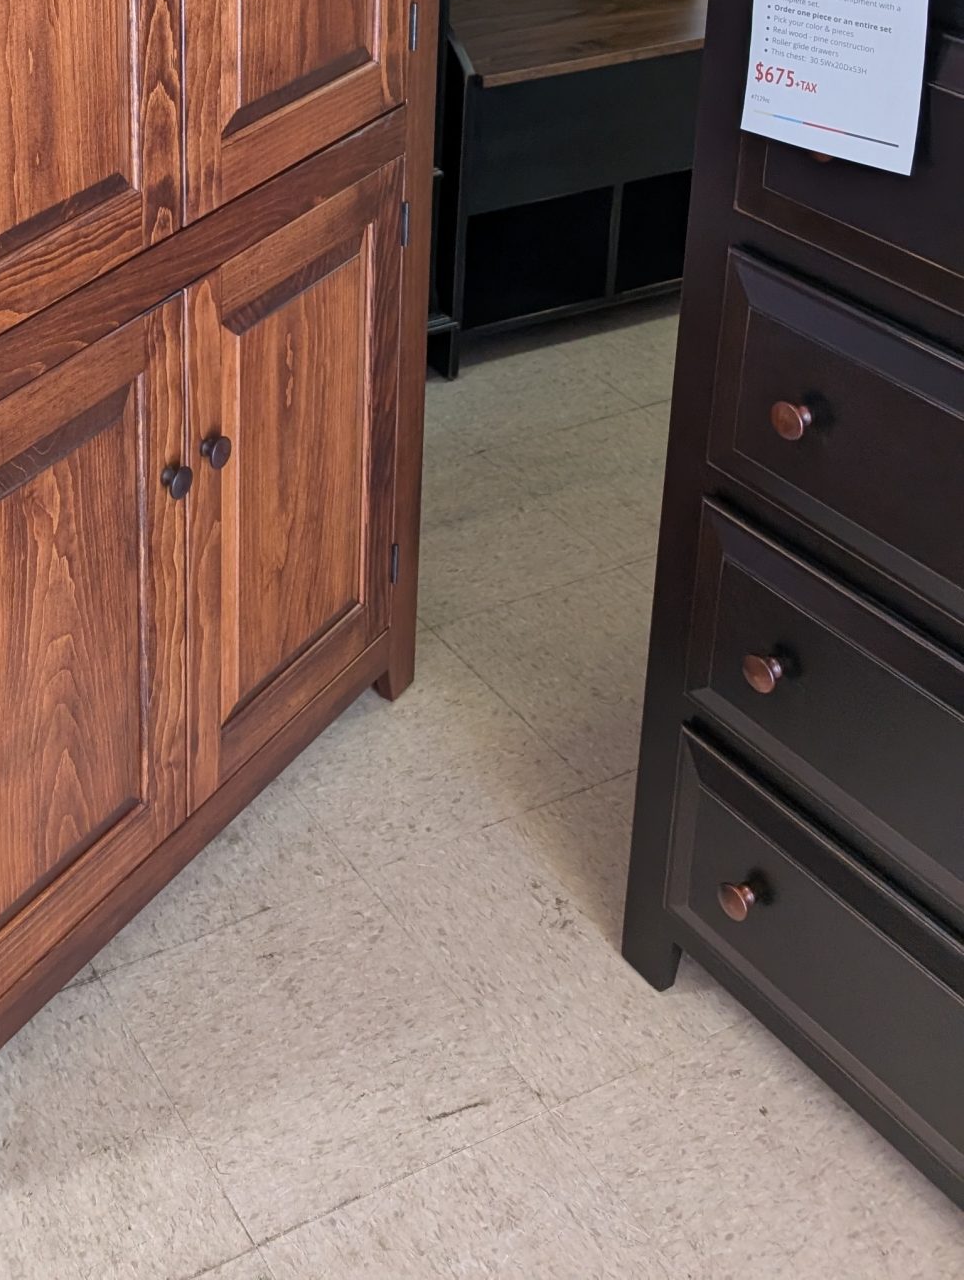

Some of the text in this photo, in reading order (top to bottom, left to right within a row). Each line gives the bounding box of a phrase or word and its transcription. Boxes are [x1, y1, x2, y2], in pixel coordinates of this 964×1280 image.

[879, 2, 895, 11] with
[773, 15, 787, 23] Pick
[789, 19, 804, 27] your
[806, 22, 823, 30] color
[832, 28, 854, 37] pieces
[775, 4, 796, 14] Order
[797, 9, 811, 17] one
[813, 12, 832, 21] piece
[855, 21, 878, 30] entire
[880, 26, 892, 34] set
[772, 26, 787, 34] Real
[789, 31, 808, 39] wood
[813, 36, 828, 44] pine
[830, 40, 874, 53] construction
[772, 37, 791, 46] Roller
[811, 46, 839, 57] drawers
[771, 48, 784, 56] This
